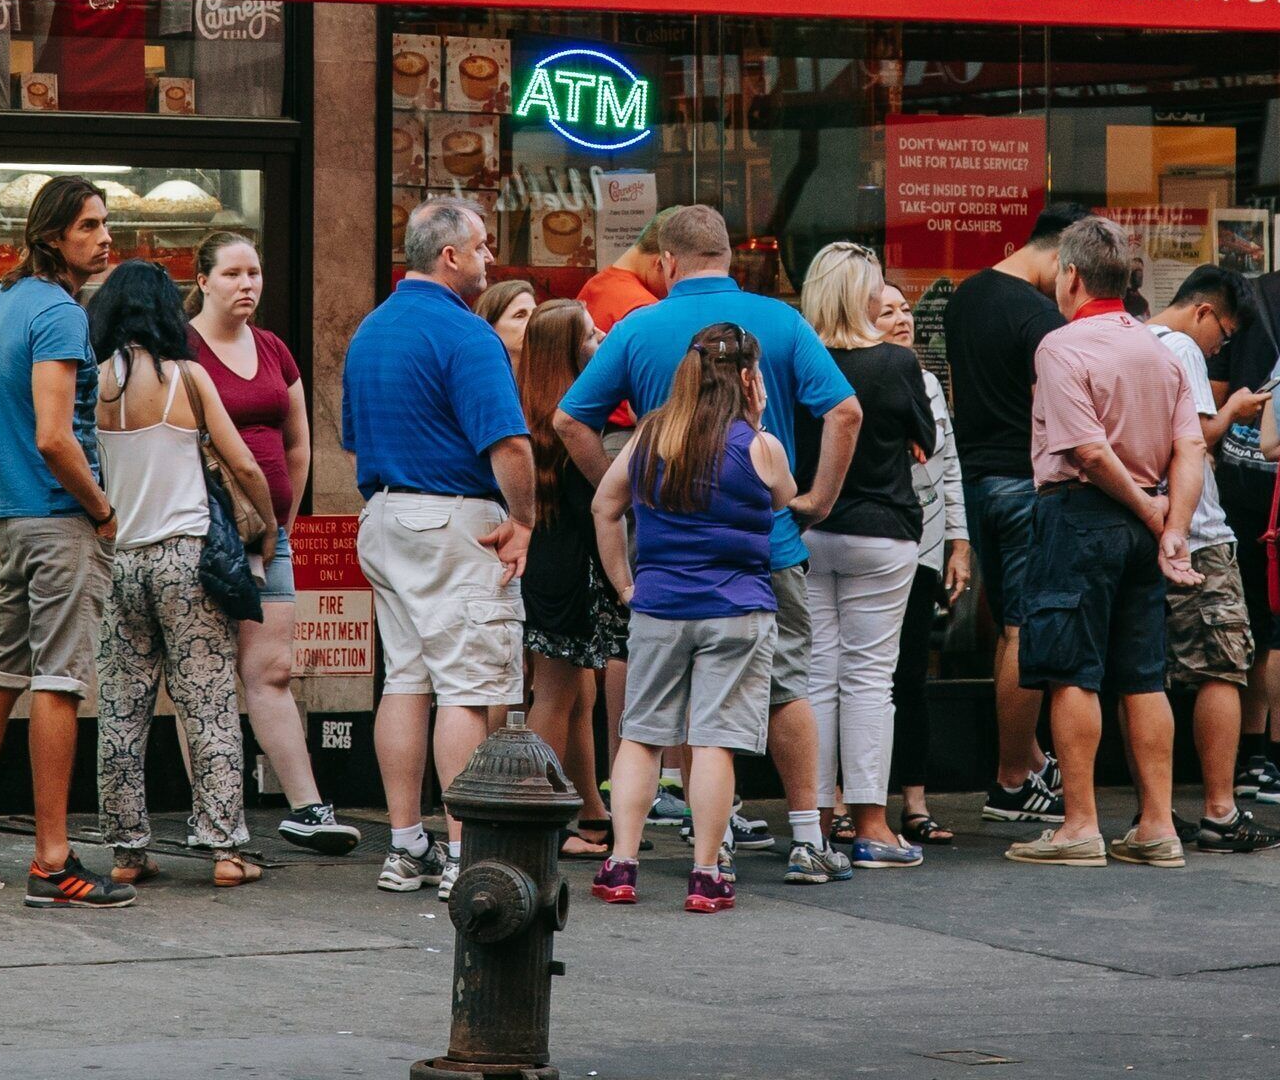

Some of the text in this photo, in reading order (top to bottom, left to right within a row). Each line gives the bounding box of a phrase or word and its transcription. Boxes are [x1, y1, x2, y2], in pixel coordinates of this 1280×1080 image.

[516, 68, 648, 130] ATM
[899, 138, 1028, 153] DON'T WANT TO WAIT IN
[899, 155, 1029, 171] LINE FOR TABLE SERVICE?
[609, 180, 644, 202] Carnegie
[898, 183, 1028, 198] COME INSIDE TO PLACE A
[900, 200, 1027, 216] TAKE-OUT ORDER WITH
[927, 219, 1002, 233] OUR CASHIERS
[315, 554, 339, 565] FIRST
[320, 570, 344, 581] ONLY
[319, 596, 344, 615] FIRE
[293, 622, 369, 641] DEPARTMENT
[296, 648, 366, 667] CONNECTION
[322, 721, 353, 736] SPOT
[321, 735, 352, 749] KMS
